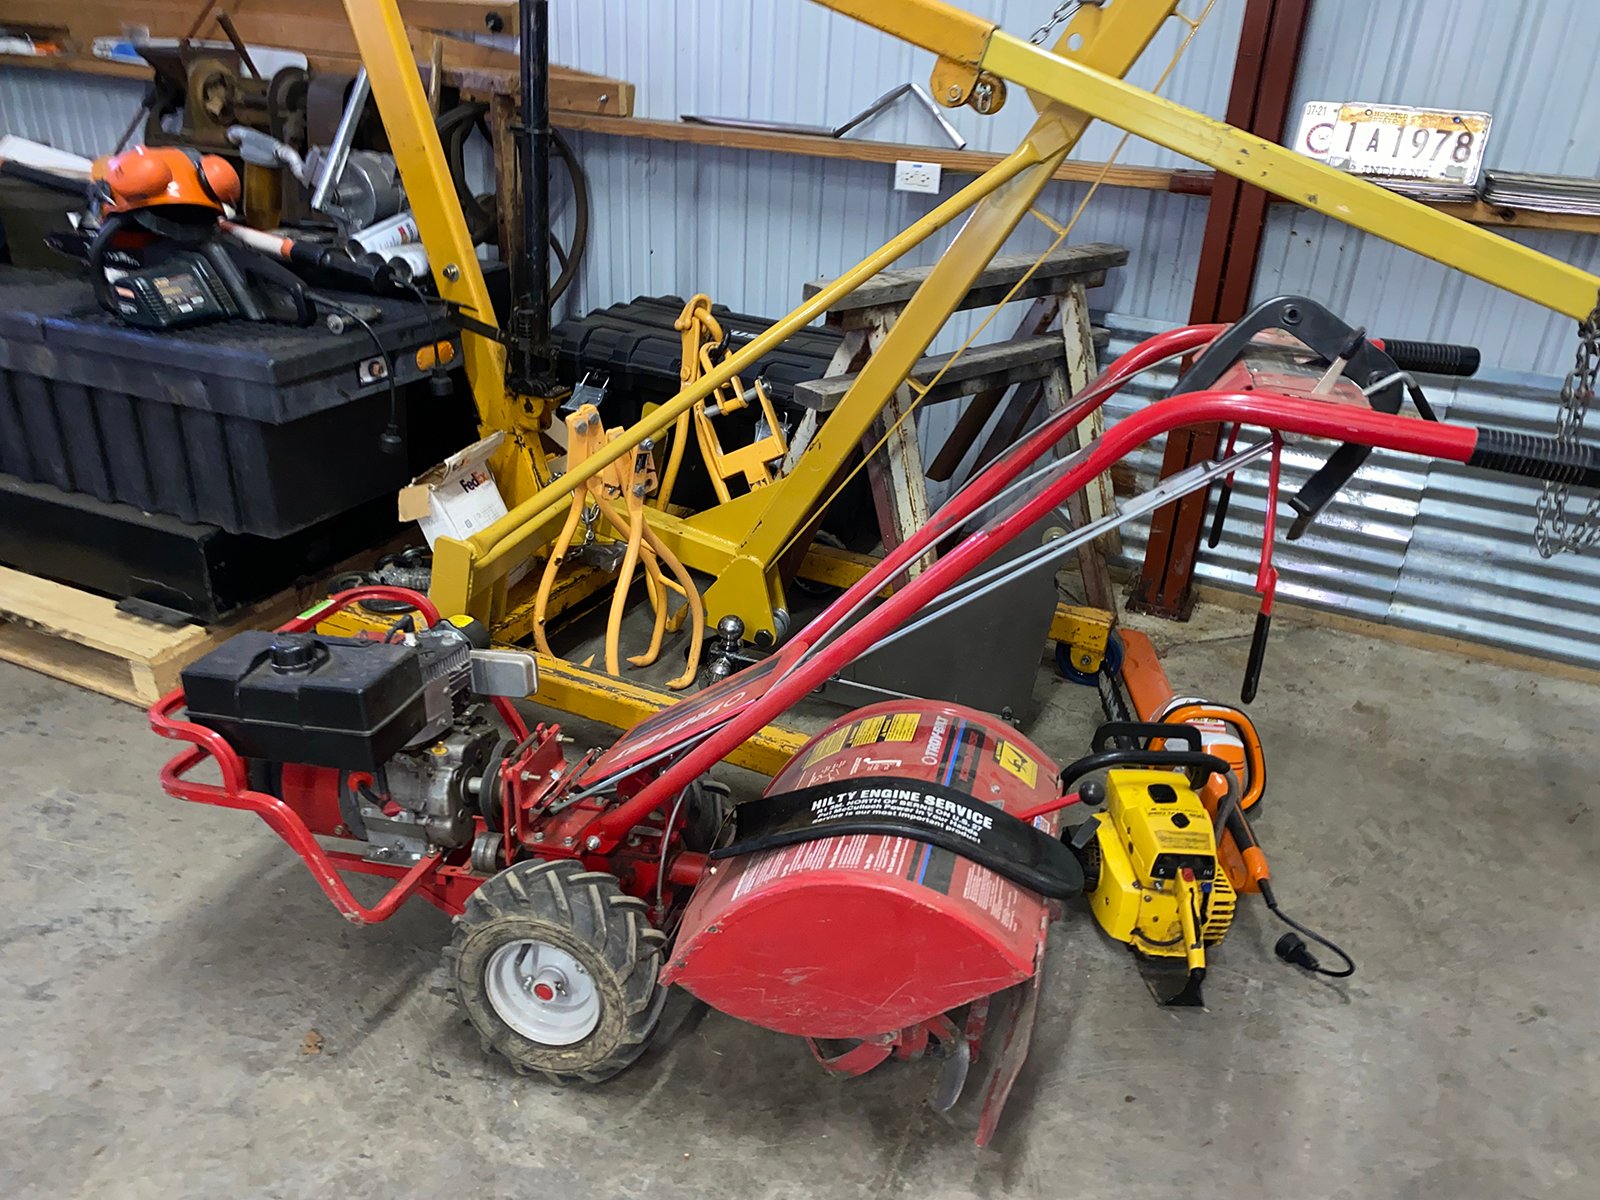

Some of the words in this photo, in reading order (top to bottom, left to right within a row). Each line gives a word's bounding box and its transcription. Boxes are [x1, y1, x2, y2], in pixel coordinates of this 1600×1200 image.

[459, 471, 489, 493] FedEx
[929, 716, 949, 759] TROY-BILT
[811, 791, 858, 811] HILTY
[860, 789, 921, 802] ENGINE
[924, 795, 993, 829] SERVICE
[834, 804, 881, 814] McCulloch
[883, 805, 915, 813] Power
[926, 811, 948, 823] Your
[949, 820, 979, 836] Hands
[847, 798, 881, 806] NORTH
[899, 801, 934, 811] BERNE
[935, 808, 951, 818] ON
[898, 811, 944, 828] important
[945, 825, 981, 844] product
